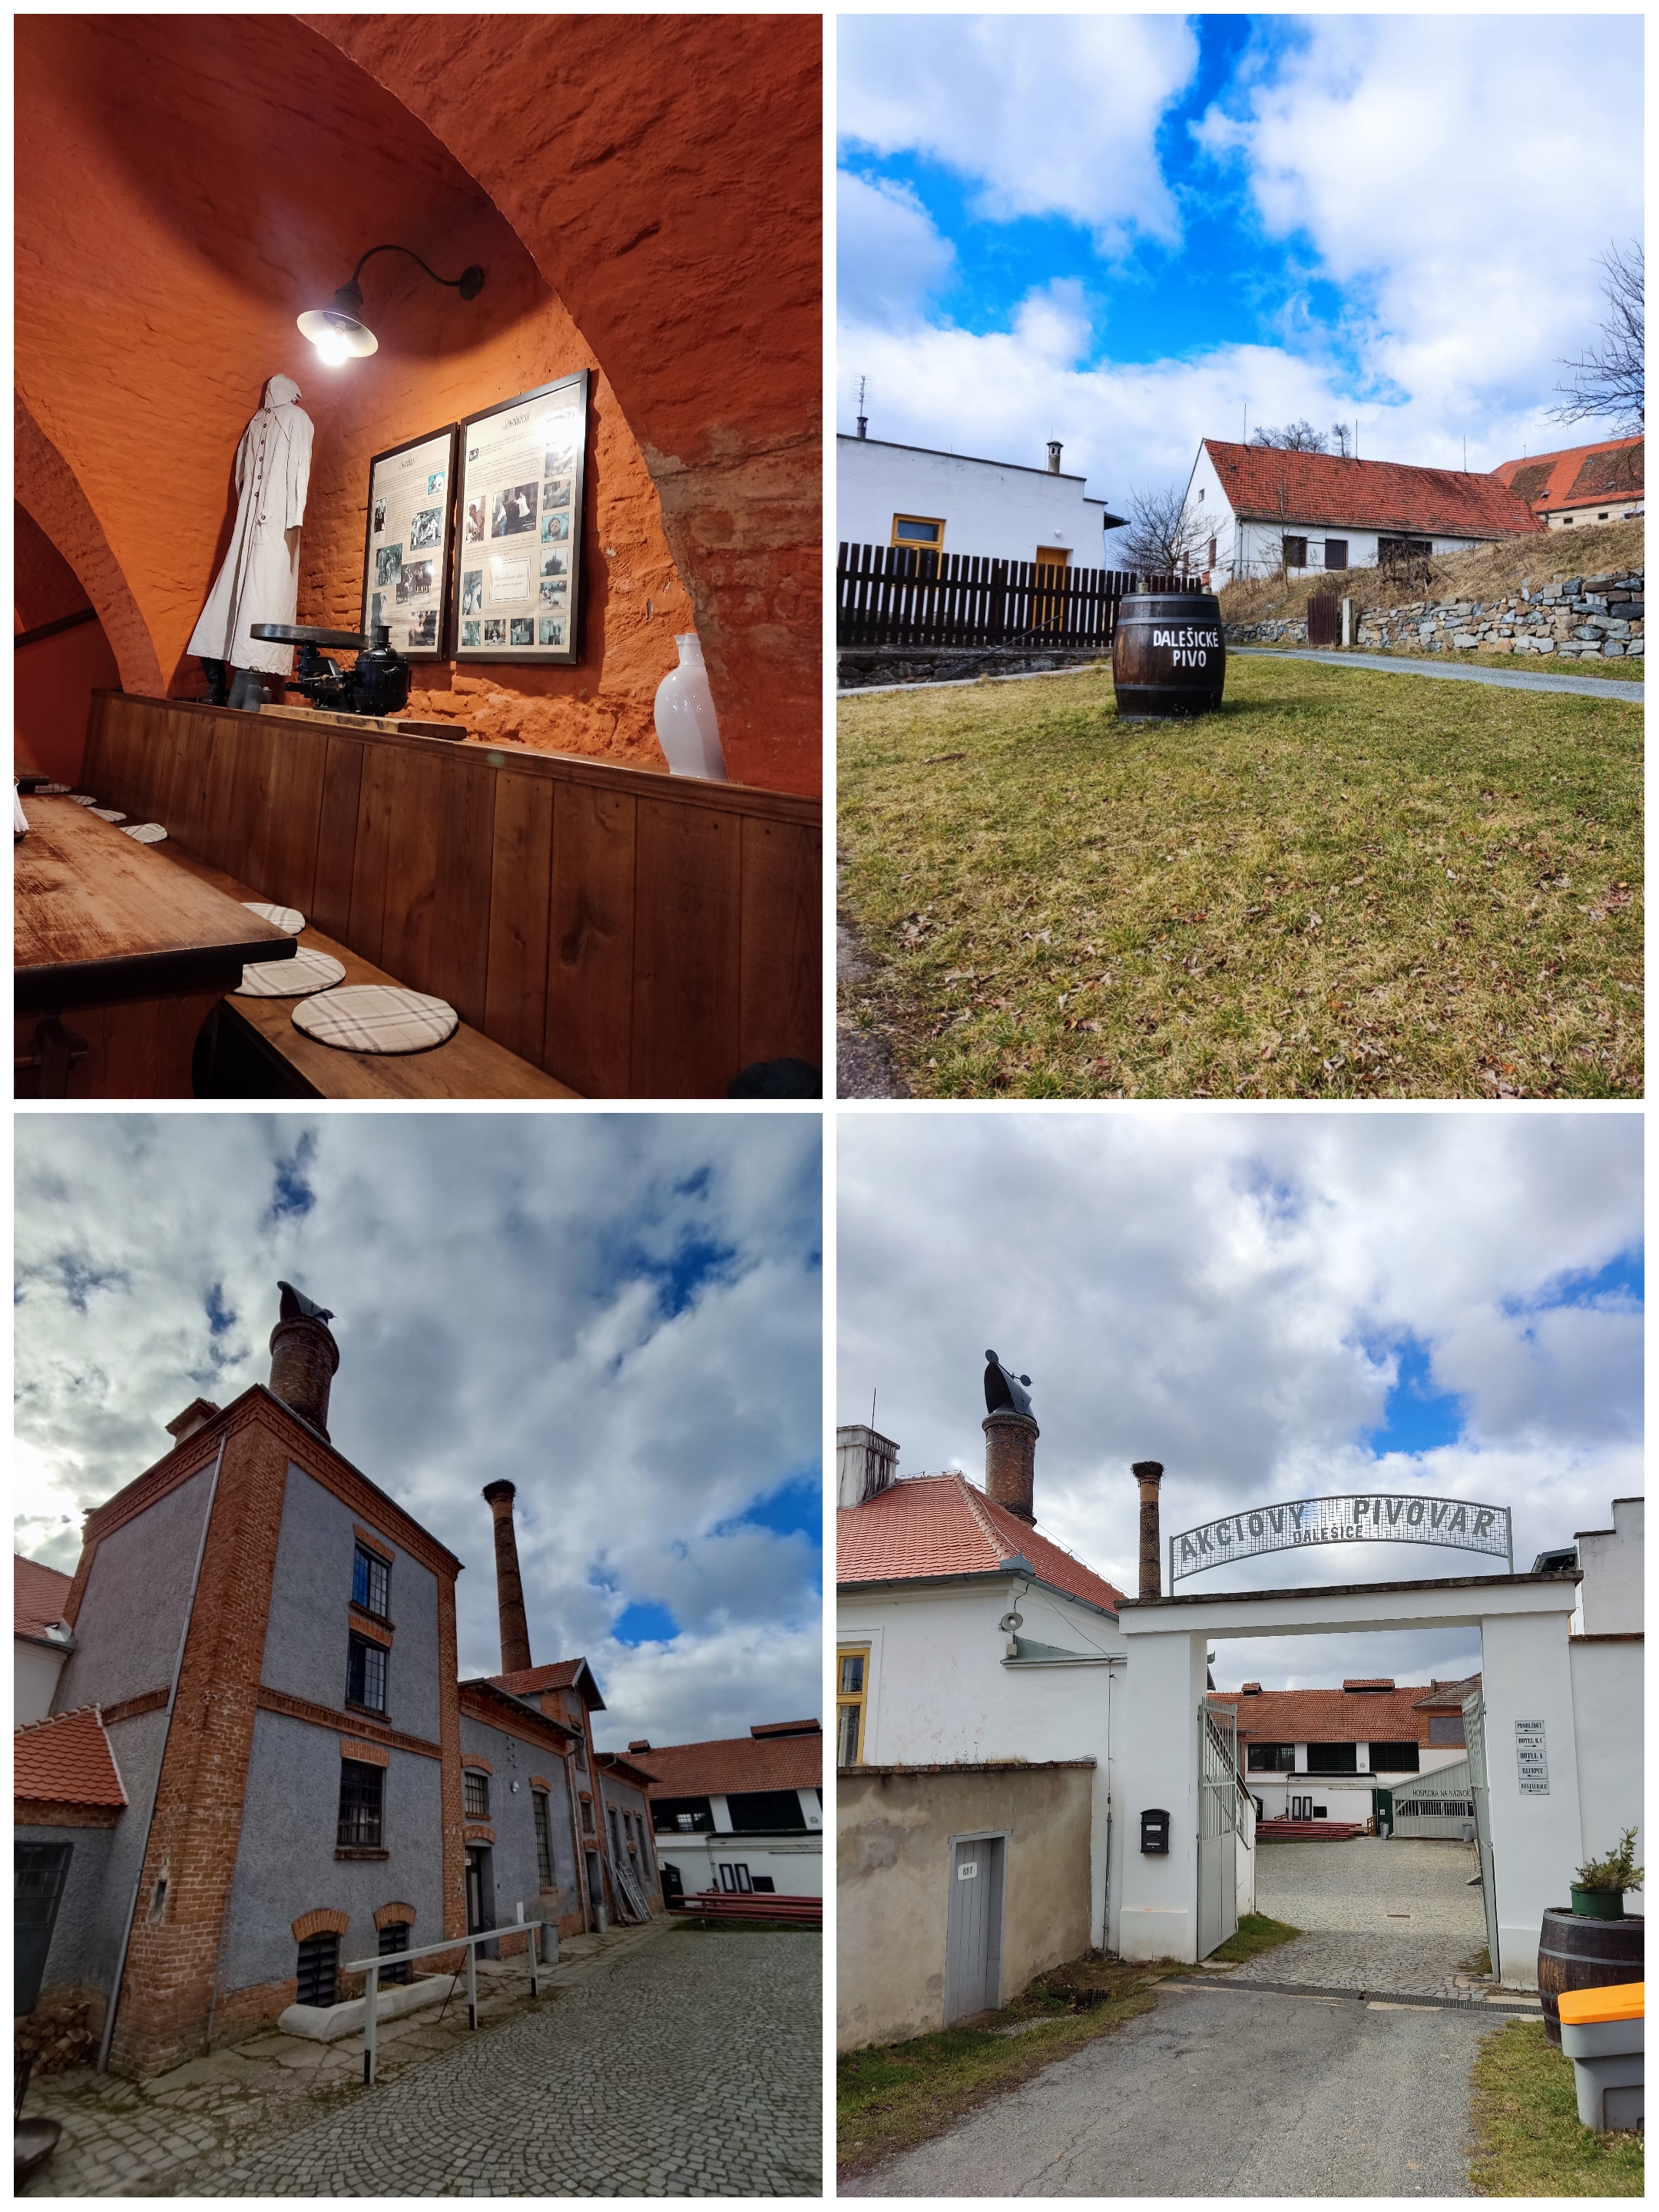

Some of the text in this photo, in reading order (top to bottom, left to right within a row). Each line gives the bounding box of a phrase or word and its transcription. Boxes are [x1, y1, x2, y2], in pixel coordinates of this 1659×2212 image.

[1153, 627, 1219, 647] DALEŠICKÉ
[1172, 650, 1207, 667] PIVO
[1353, 1499, 1495, 1538] PIVOVAR
[1293, 1522, 1363, 1543] DALEŠICE
